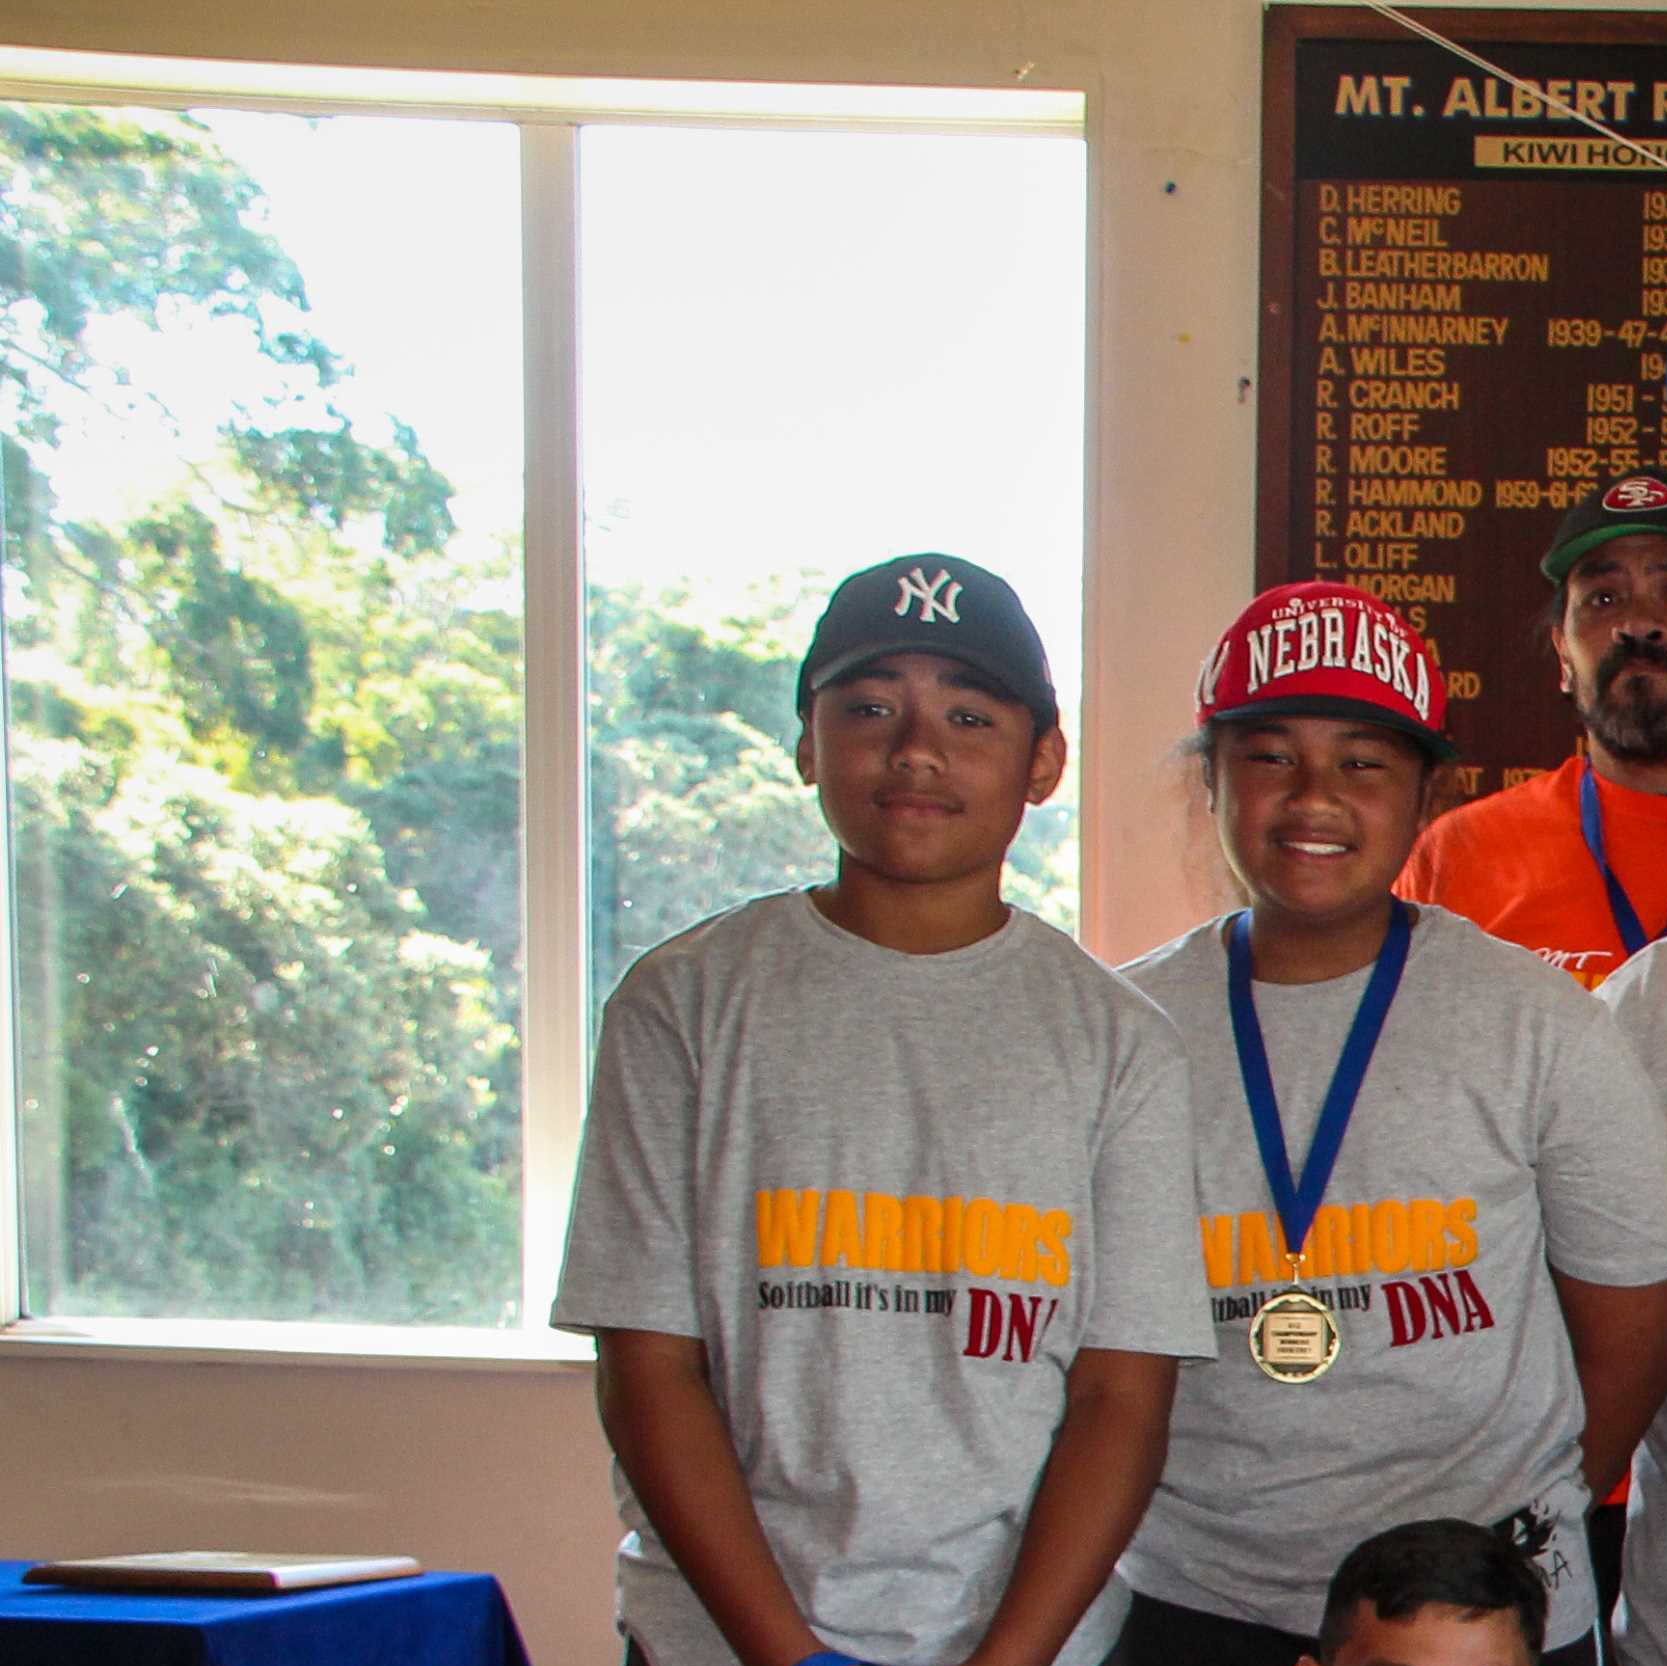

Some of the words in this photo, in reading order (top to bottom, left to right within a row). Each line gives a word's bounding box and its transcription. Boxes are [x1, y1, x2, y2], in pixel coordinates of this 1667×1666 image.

[1333, 75, 1425, 118] MT.
[1441, 77, 1636, 123] ALBERT
[1502, 143, 1577, 164] KIWI
[1319, 186, 1341, 213] D.
[1347, 187, 1461, 215] HERRING
[1319, 219, 1341, 246] C.
[1318, 254, 1341, 277] B.
[1346, 253, 1549, 282] LEATHERBARRON
[1317, 286, 1338, 311] J.
[1345, 284, 1462, 311] BANHAM
[1318, 318, 1345, 344] A.
[1318, 351, 1345, 376] A.
[1351, 350, 1446, 377] WILES
[1316, 381, 1338, 407] R.
[1350, 382, 1460, 410] CRANCH
[1316, 413, 1338, 440] R.
[1350, 414, 1420, 440] ROFF
[1316, 446, 1338, 473] R.
[1350, 446, 1447, 475] MOORE
[1315, 478, 1337, 506] R.
[1349, 478, 1483, 507] HAMMOND
[1315, 510, 1337, 537] R.
[1346, 510, 1465, 539] ACKLAND
[1315, 542, 1338, 569] L.
[1344, 542, 1419, 570] OLIFF
[1246, 608, 1431, 721] NEBRASKA
[754, 1187, 1073, 1288] WARRIORS
[758, 1280, 850, 1312] Softball
[855, 1280, 889, 1313] it's
[895, 1284, 922, 1313] in
[925, 1288, 957, 1317] my
[1338, 1283, 1371, 1312] my
[1380, 1269, 1495, 1347] DNA
